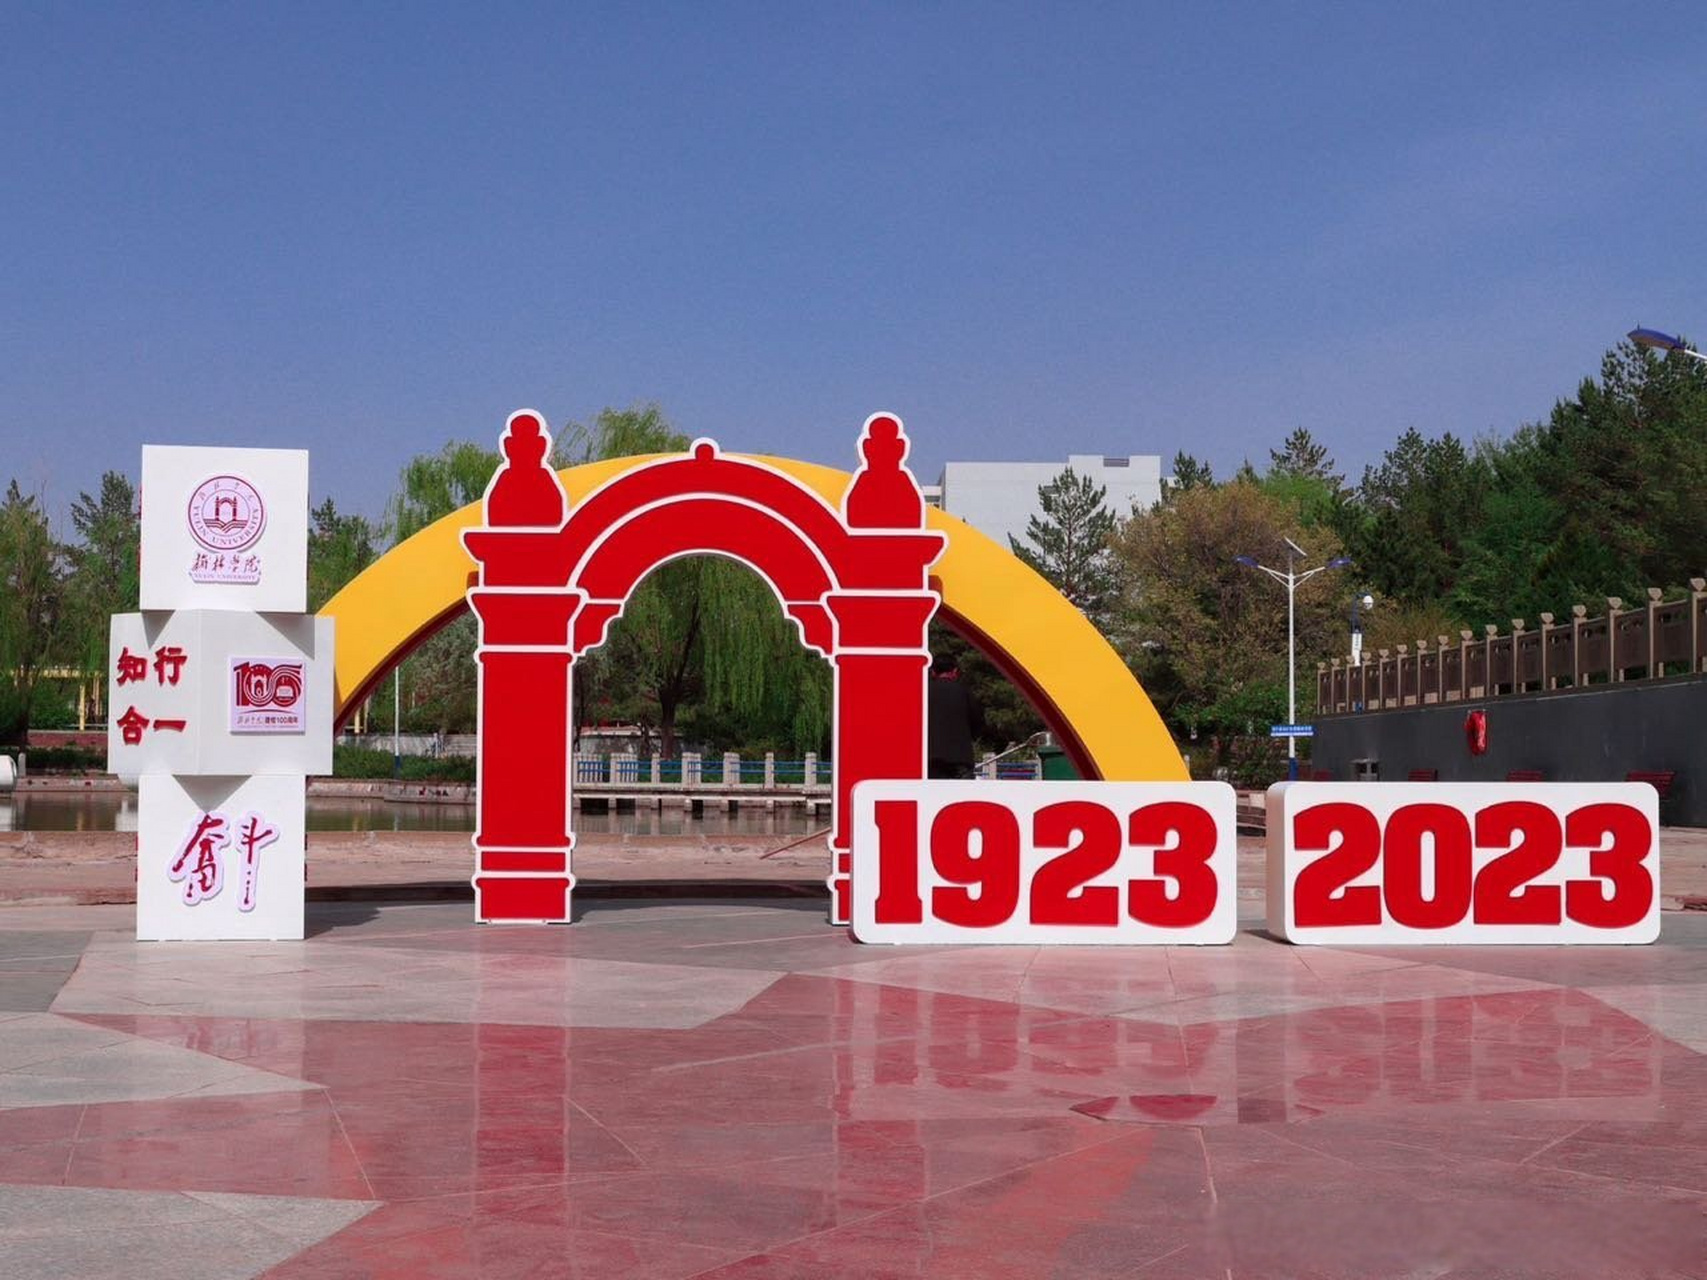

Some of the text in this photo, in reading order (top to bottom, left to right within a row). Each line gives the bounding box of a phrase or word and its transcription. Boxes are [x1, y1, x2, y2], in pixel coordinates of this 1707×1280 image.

[212, 508, 259, 545] UNIVERSITY
[116, 646, 188, 687] 知行
[116, 705, 188, 746] 合一
[874, 800, 1218, 928] 1923
[1293, 801, 1653, 929] 2023
